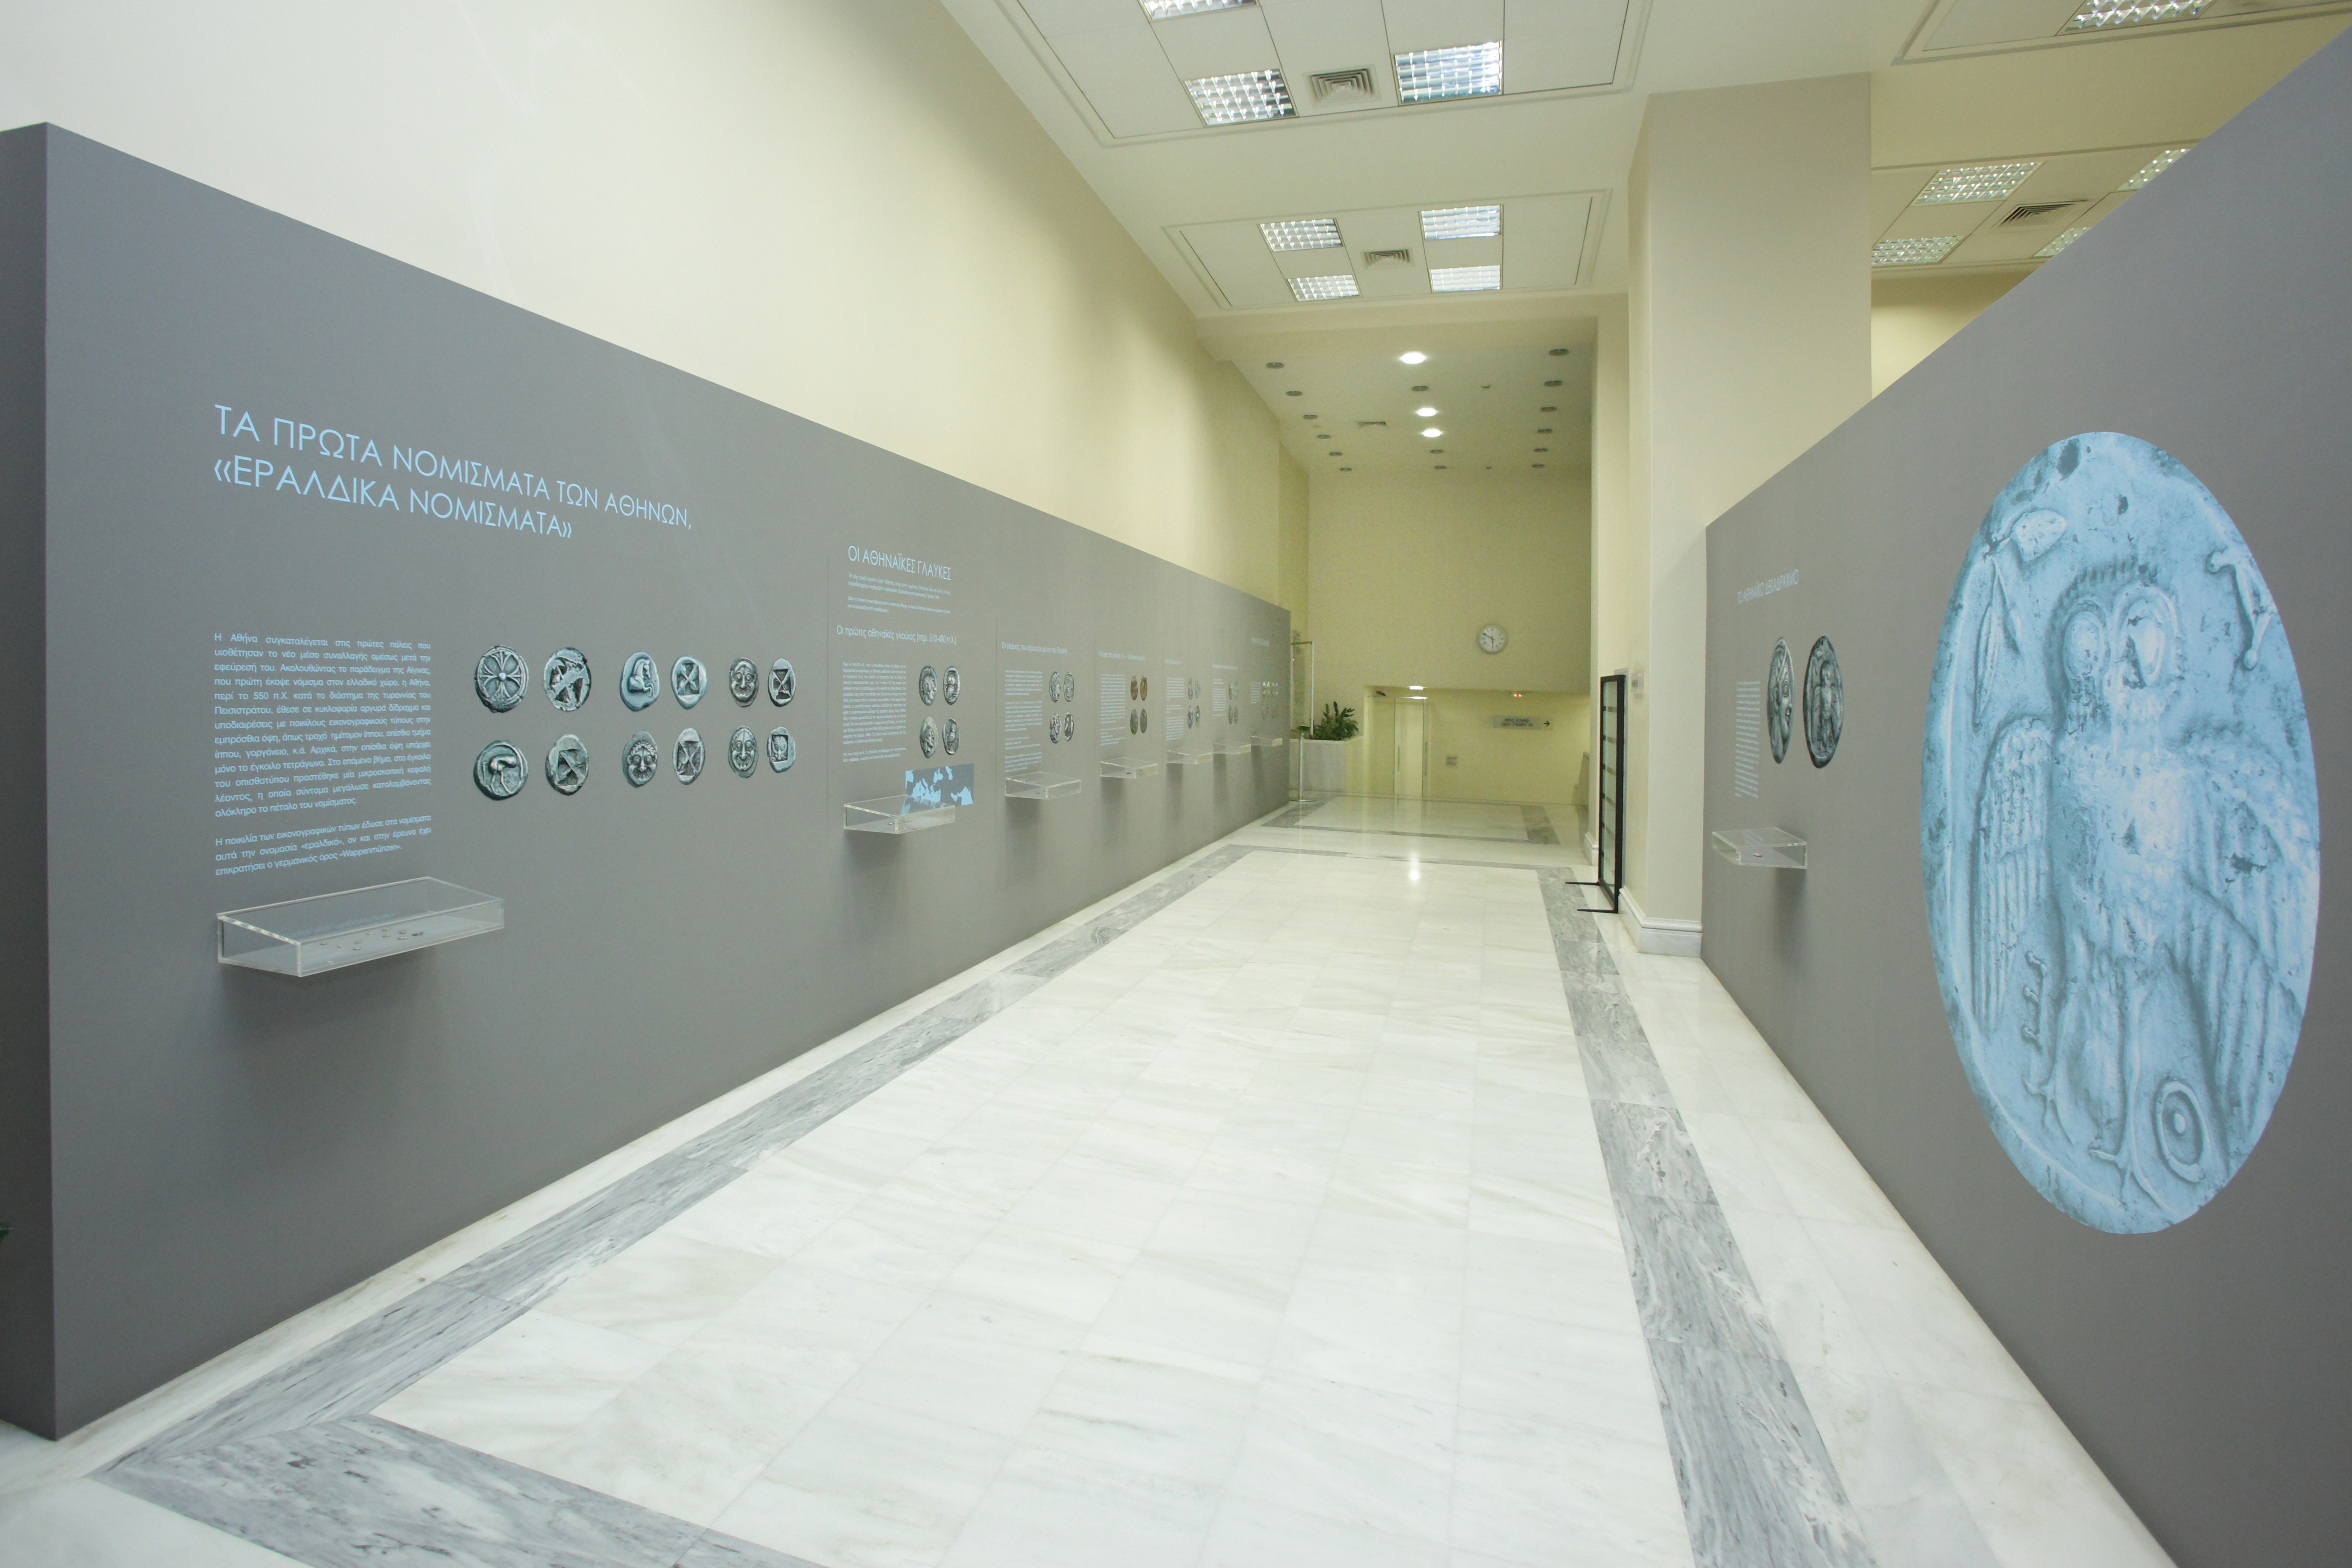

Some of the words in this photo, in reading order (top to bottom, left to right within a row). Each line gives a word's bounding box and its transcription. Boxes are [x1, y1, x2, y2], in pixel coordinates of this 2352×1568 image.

[214, 404, 260, 442] ΤΑ
[274, 418, 382, 467] ΠΡΩΤΑ
[393, 445, 550, 500] ΝΟΜΙΣΜΑΤΑ
[556, 480, 598, 509] ΤΩΝ
[604, 493, 692, 530] ΑΘΗΝΩΝ,
[214, 455, 400, 511] «ΕΡΑΛΔΙΚΑ
[410, 488, 573, 539] ΝΟΜΙΣΜΑΤΑ»
[848, 545, 859, 562] ΟΙ
[862, 549, 916, 573] ΑΘΗΝΑΪΚΕΣ
[918, 560, 951, 580] ΓΛΑΥΚΕΣ
[837, 625, 843, 634] Οι
[845, 627, 867, 639] πρώτες
[230, 633, 258, 644] Αθήνα
[266, 637, 328, 647] συγκαταλέγεται
[357, 640, 384, 649] πρώτες
[390, 641, 412, 650] πόλεις
[214, 648, 263, 658] υιοθέτησαν
[300, 650, 320, 659] μέσο
[323, 652, 368, 661] συναλλαγής
[371, 653, 398, 661] αμέσως
[214, 663, 257, 673] εφεύρεσή
[280, 664, 335, 673] Ακολουθώντας
[350, 665, 390, 674] παράδειγμα
[235, 678, 262, 687] πρώτη
[266, 678, 290, 687] έκοψε
[293, 678, 323, 687] νόμισμα
[214, 691, 233, 701] περί
[329, 691, 363, 700] διάστημα
[276, 705, 299, 713] έθεσε
[315, 704, 358, 713] κυκλοφορία
[360, 704, 386, 713] αργυρά
[214, 720, 273, 730] υποδιαιρέσεις
[289, 719, 326, 727] ποικίλους
[329, 717, 387, 726] εικονογραφικούς
[214, 735, 260, 745] εμπρόσθια
[262, 734, 280, 743] όψη,
[282, 733, 303, 742] όπως
[305, 732, 328, 741] τροχό
[245, 748, 289, 758] γοργόνειο,
[214, 764, 236, 775] μόνο
[250, 762, 281, 772] έγκοιλο
[407, 753, 431, 762] έγκοιλο
[235, 776, 289, 786] οπισθοτύπου
[294, 772, 339, 783] προστέθηκε
[343, 770, 354, 779] μία
[407, 764, 431, 774] κεφαλή
[215, 794, 252, 802] λέοντος,
[268, 789, 291, 798] οποία
[333, 784, 369, 794] μεγάλωσε
[215, 807, 257, 817] ολόκληρο
[270, 803, 298, 811] πέταλο
[215, 838, 222, 846] Η
[225, 833, 258, 845] ποικιλία
[276, 825, 336, 839] εικονογραφικών
[215, 851, 237, 861] αυτά
[260, 843, 297, 855] ονομασία
[419, 827, 431, 835] έχει
[216, 863, 265, 875] επικρατήσει
[274, 854, 317, 869] γερμανικός
[319, 853, 338, 861] όρος
